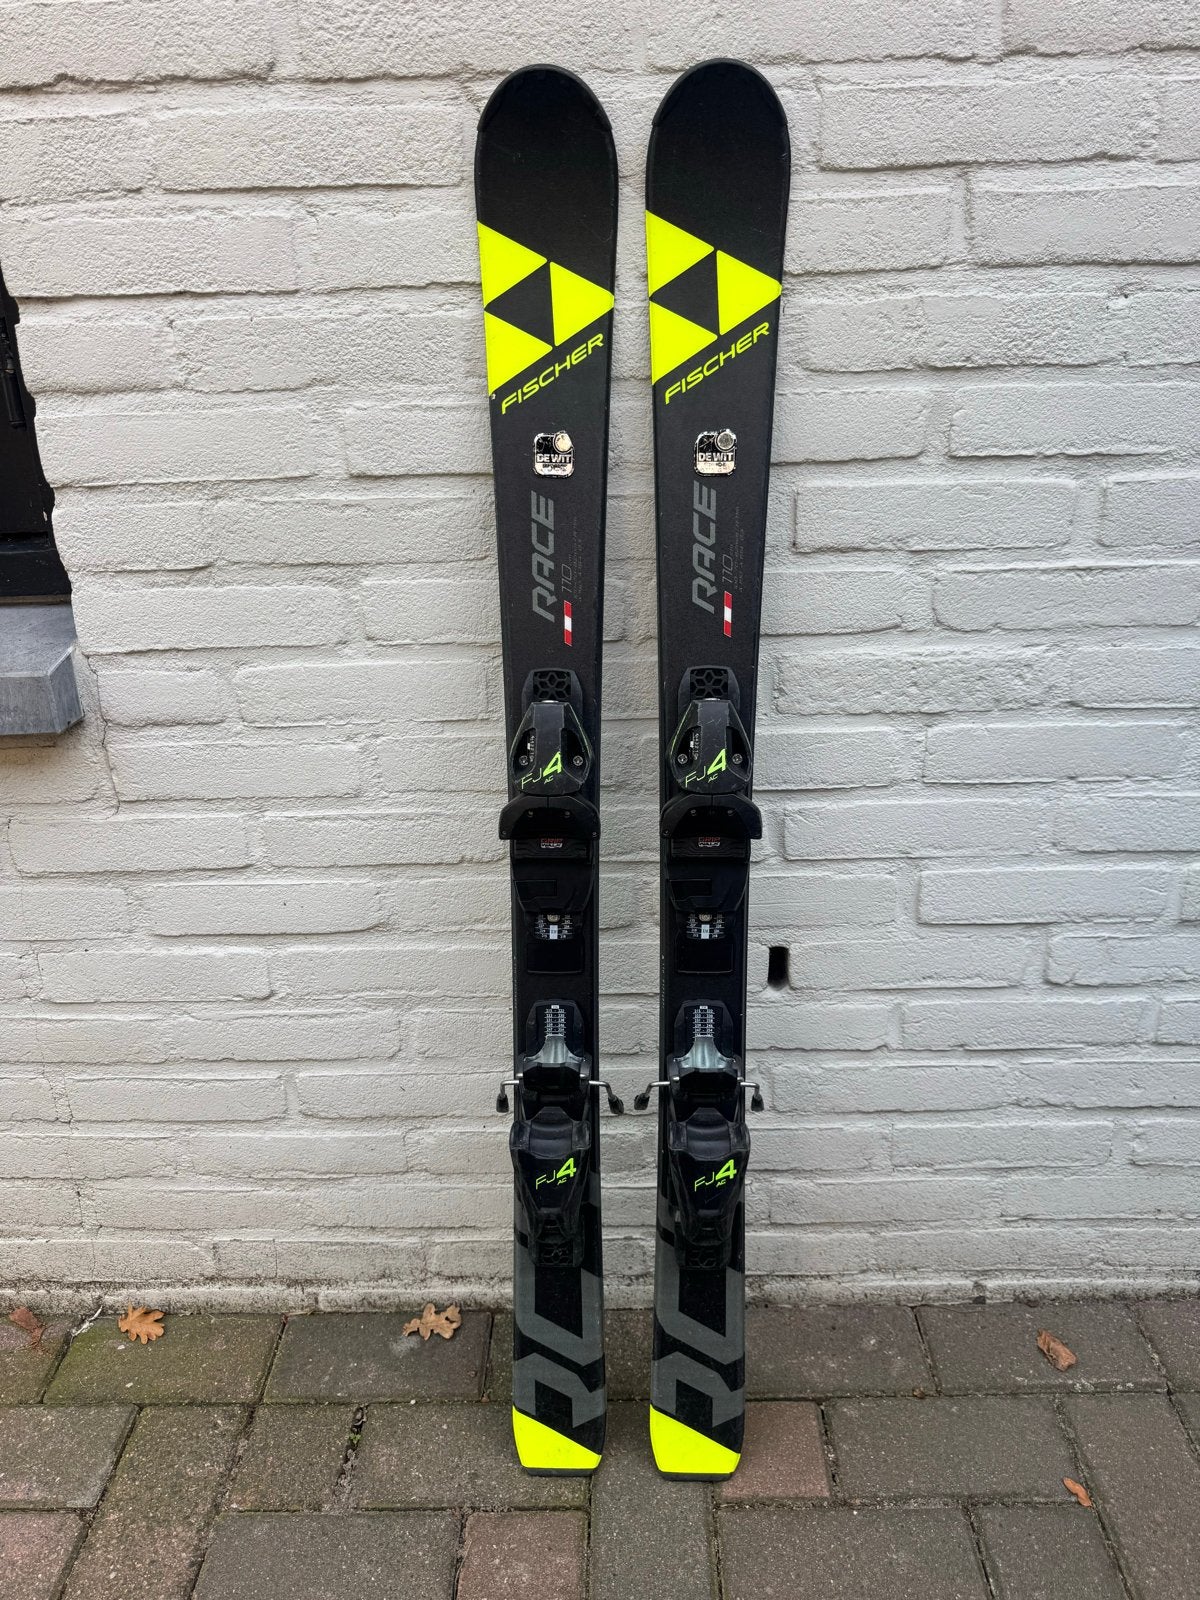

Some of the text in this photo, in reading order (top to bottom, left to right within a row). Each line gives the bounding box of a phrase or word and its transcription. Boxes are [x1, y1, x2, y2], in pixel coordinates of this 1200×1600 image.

[501, 332, 604, 415] FISCHER
[664, 321, 770, 405] FISCHER
[536, 453, 571, 463] DE WIT
[698, 452, 733, 461] DE WIT
[530, 490, 559, 623] RACE
[691, 480, 718, 614] RACE
[721, 554, 734, 584] 110
[561, 563, 573, 593] 110
